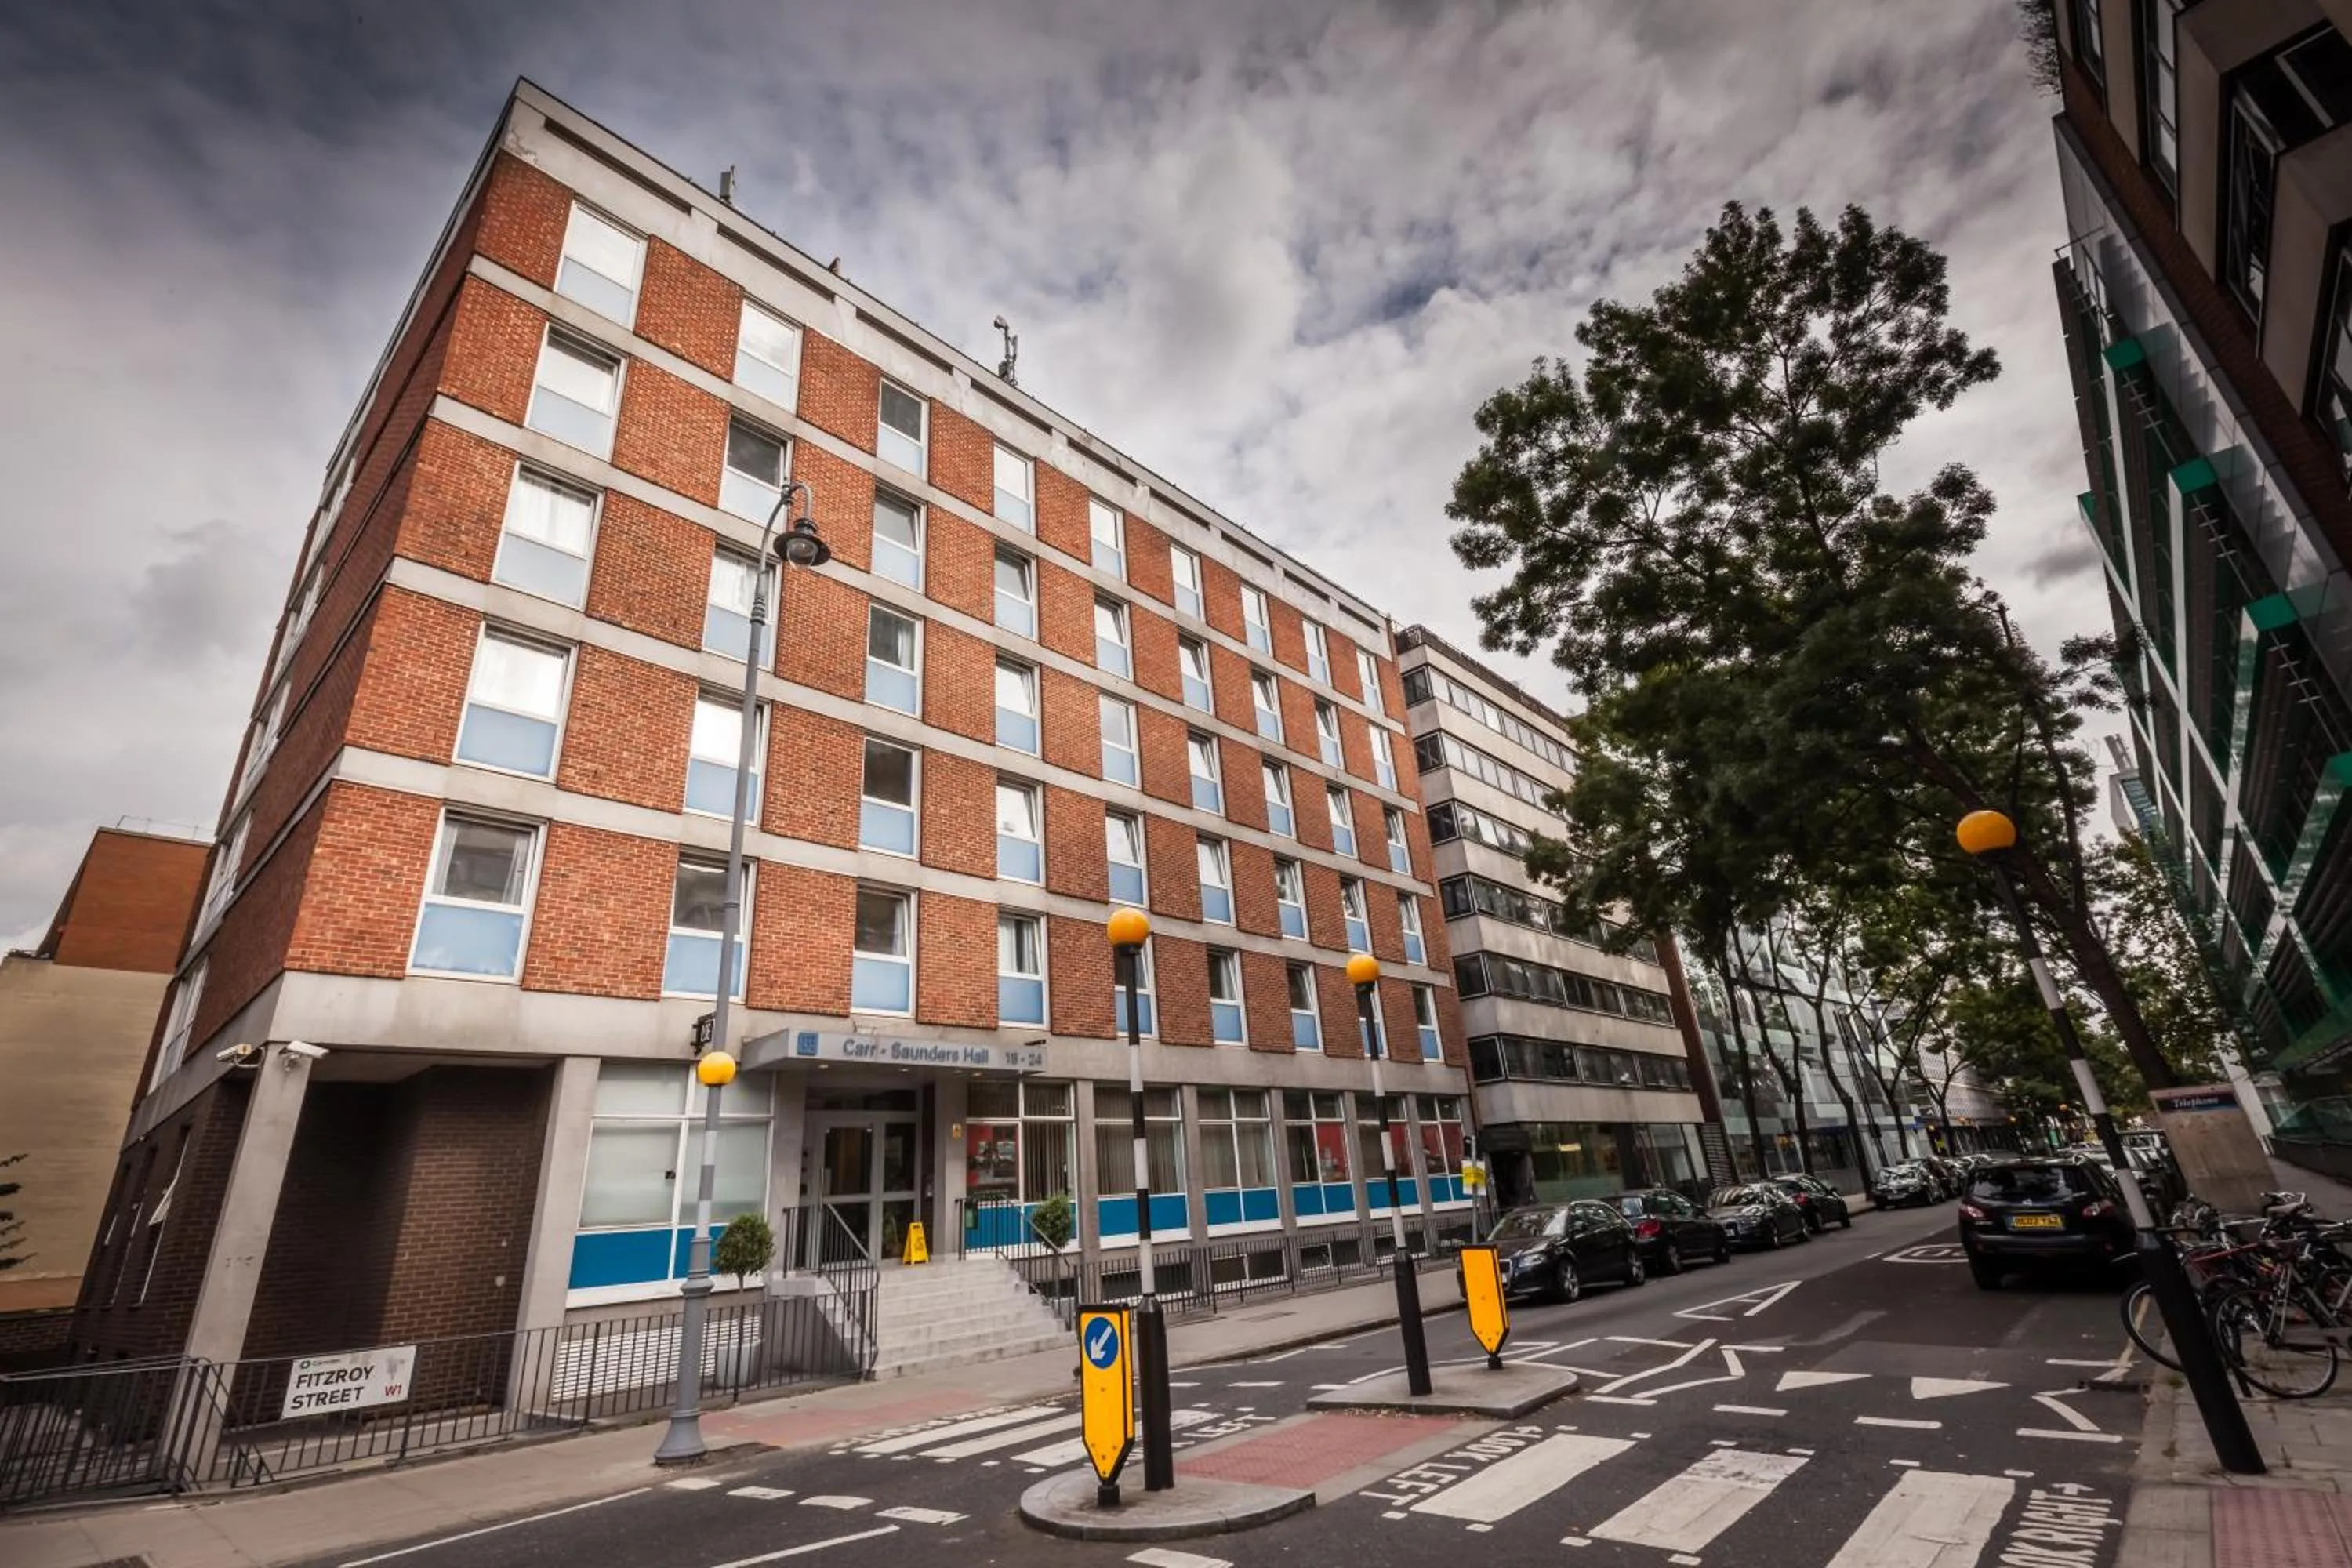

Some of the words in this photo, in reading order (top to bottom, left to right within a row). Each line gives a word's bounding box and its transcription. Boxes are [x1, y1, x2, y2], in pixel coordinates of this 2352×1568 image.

[843, 1038, 877, 1058] Carr
[891, 1041, 959, 1063] Saunders
[964, 1047, 989, 1064] Hall
[1027, 1053, 1043, 1067] 24
[296, 1365, 375, 1389] FITZROY
[290, 1386, 365, 1410] STREET
[384, 1385, 402, 1396] W1
[1181, 1414, 1276, 1439] LEFT
[1444, 1431, 1543, 1462] LOOK
[1359, 1462, 1472, 1506] LEFT
[2008, 1489, 2123, 1548] RIGHT
